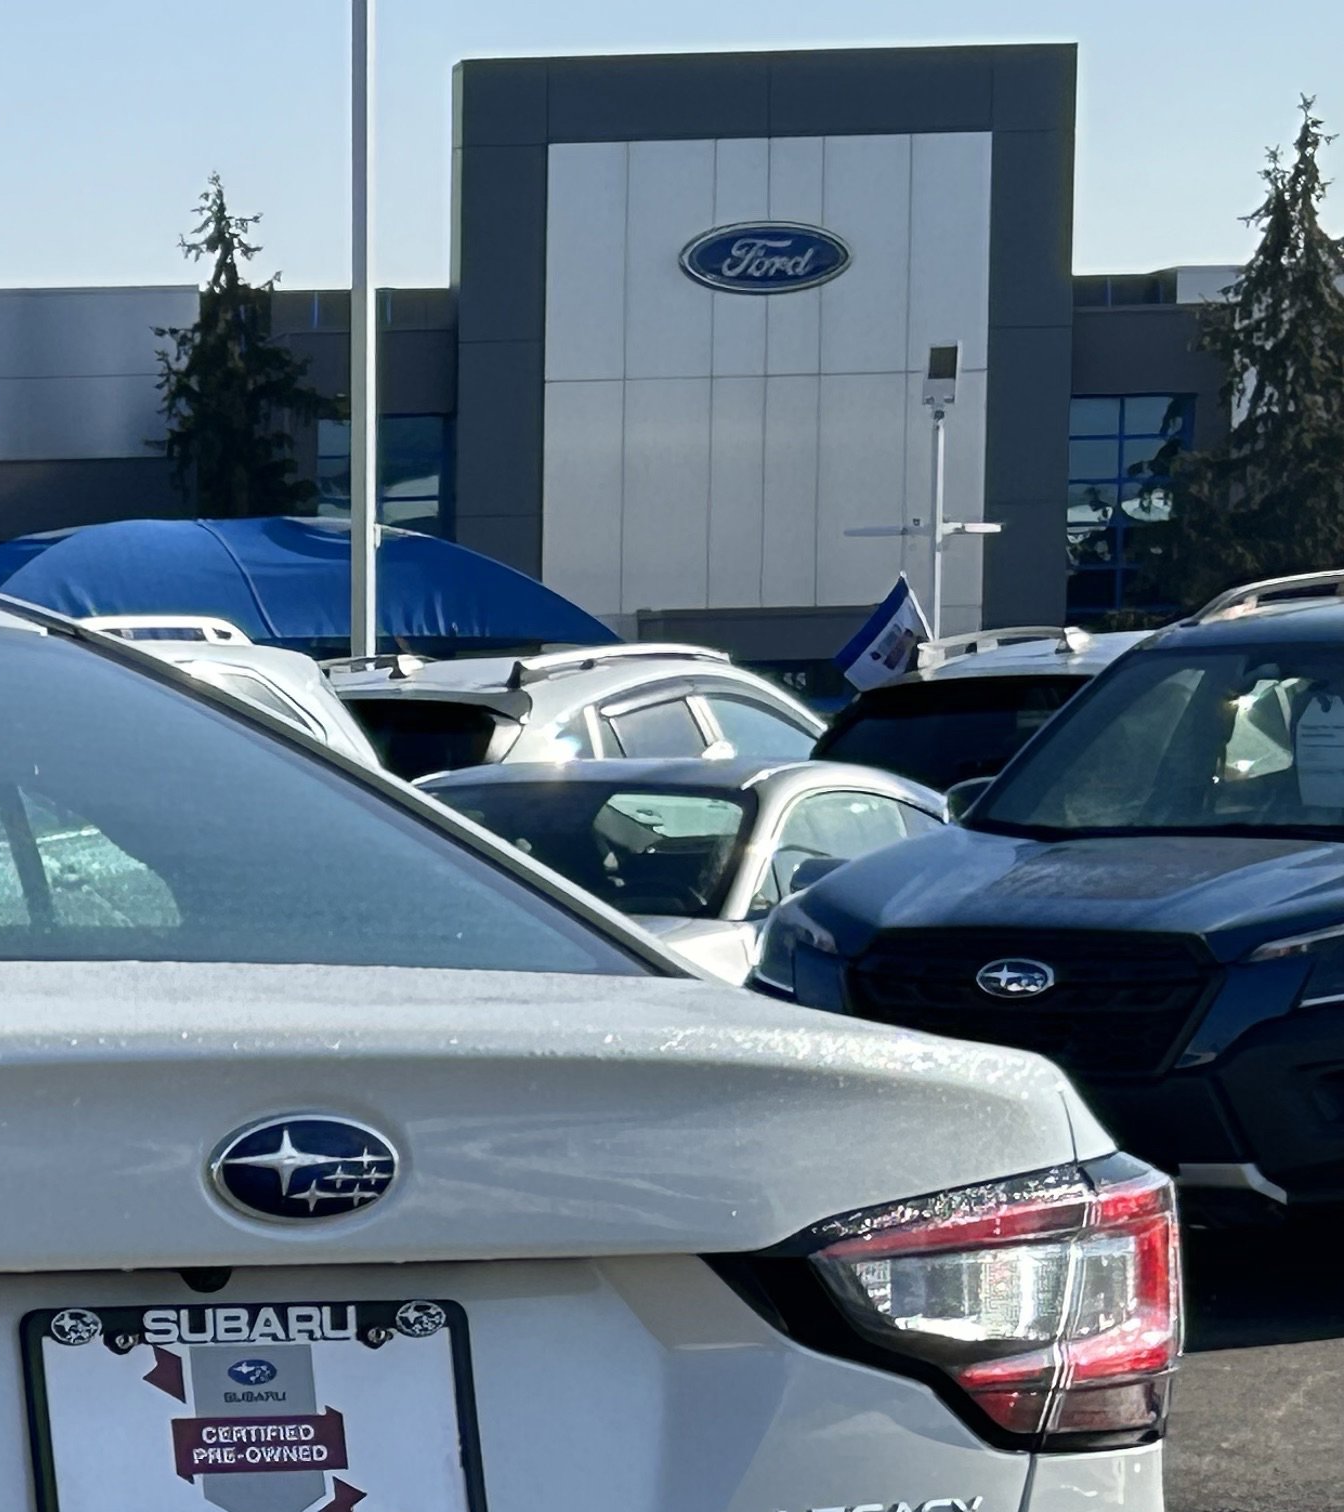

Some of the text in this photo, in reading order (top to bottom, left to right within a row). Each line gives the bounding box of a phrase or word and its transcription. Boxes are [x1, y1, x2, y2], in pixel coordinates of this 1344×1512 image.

[722, 238, 814, 277] Ford
[143, 1305, 358, 1344] SUBARU
[223, 1390, 288, 1403] SUBARU
[201, 1424, 315, 1445] CERTIFIED
[192, 1445, 328, 1464] PRE-OWNED
